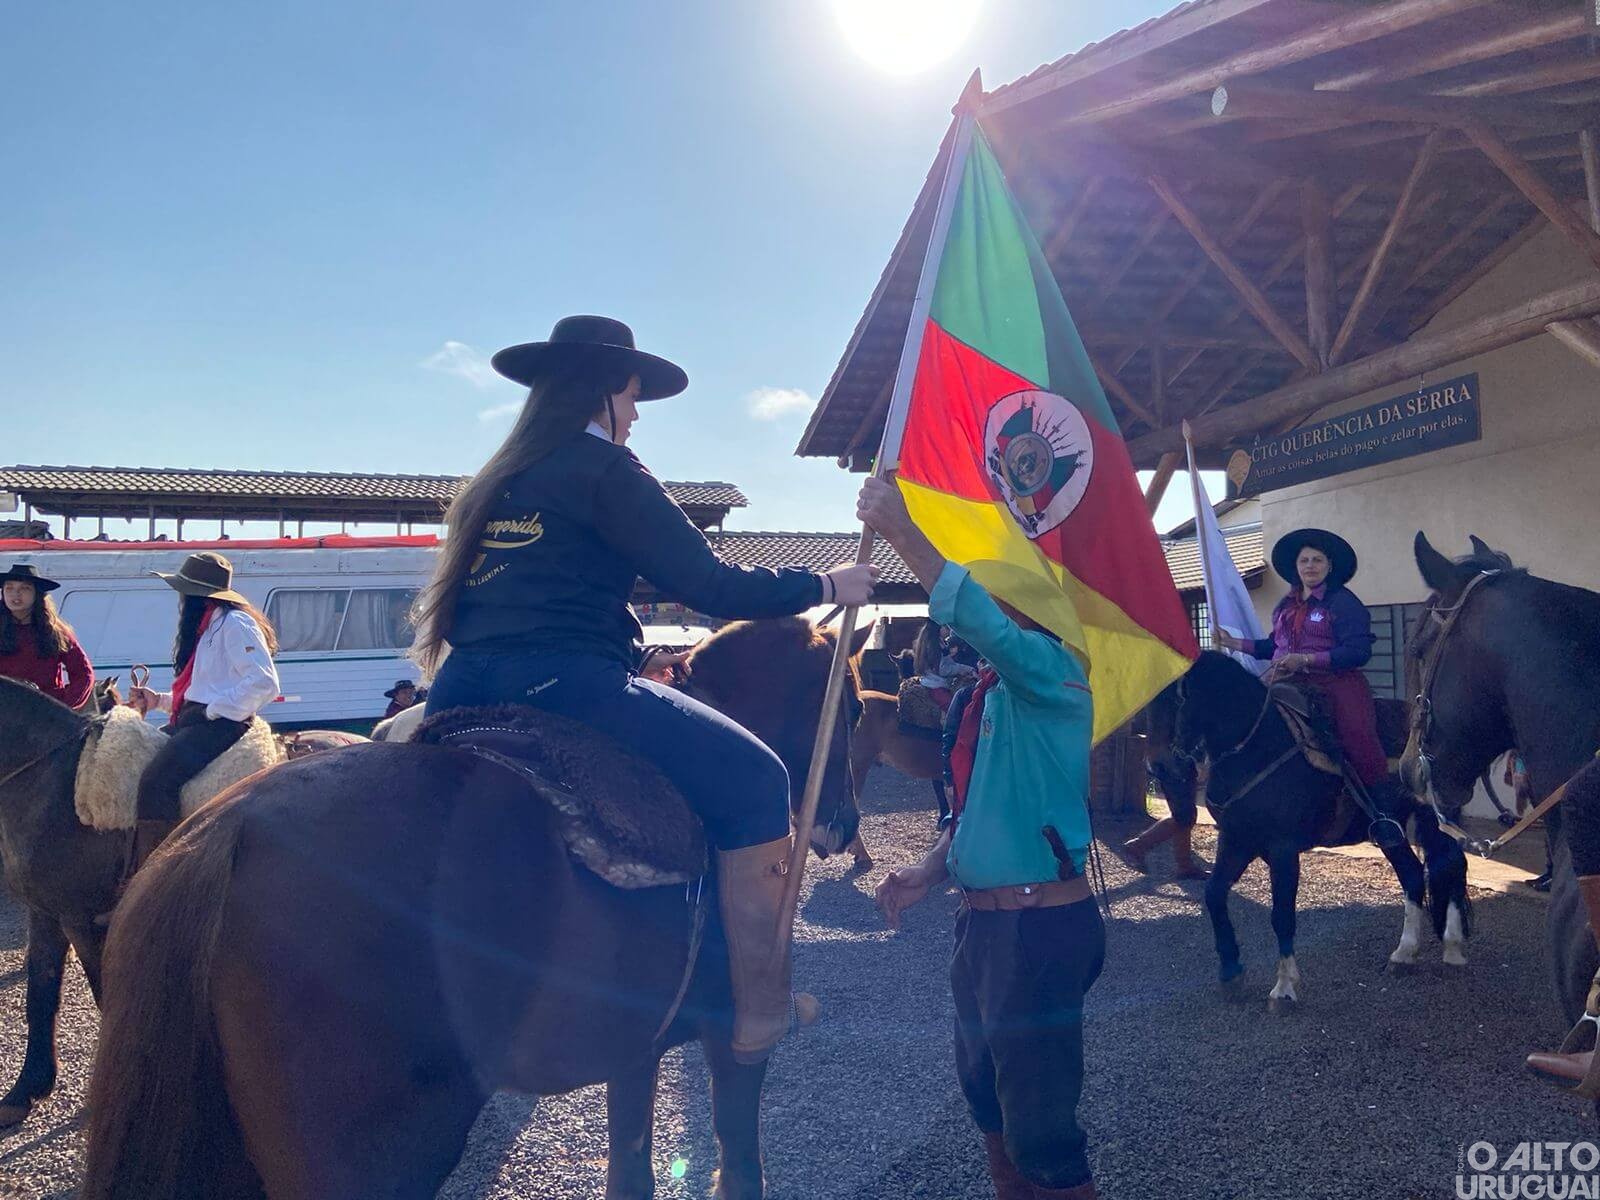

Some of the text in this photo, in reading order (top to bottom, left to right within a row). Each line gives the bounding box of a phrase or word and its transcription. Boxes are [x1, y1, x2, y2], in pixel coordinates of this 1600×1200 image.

[1251, 383, 1472, 463] CTG QUERÊNCIA DA SERRA
[1288, 456, 1314, 471] coisas
[1315, 450, 1339, 463] belas
[1341, 443, 1353, 457] do
[1354, 438, 1380, 456] pago
[1382, 435, 1389, 445] e
[1391, 427, 1417, 442] zelar
[1419, 421, 1438, 439] por
[1441, 414, 1467, 429] elas.
